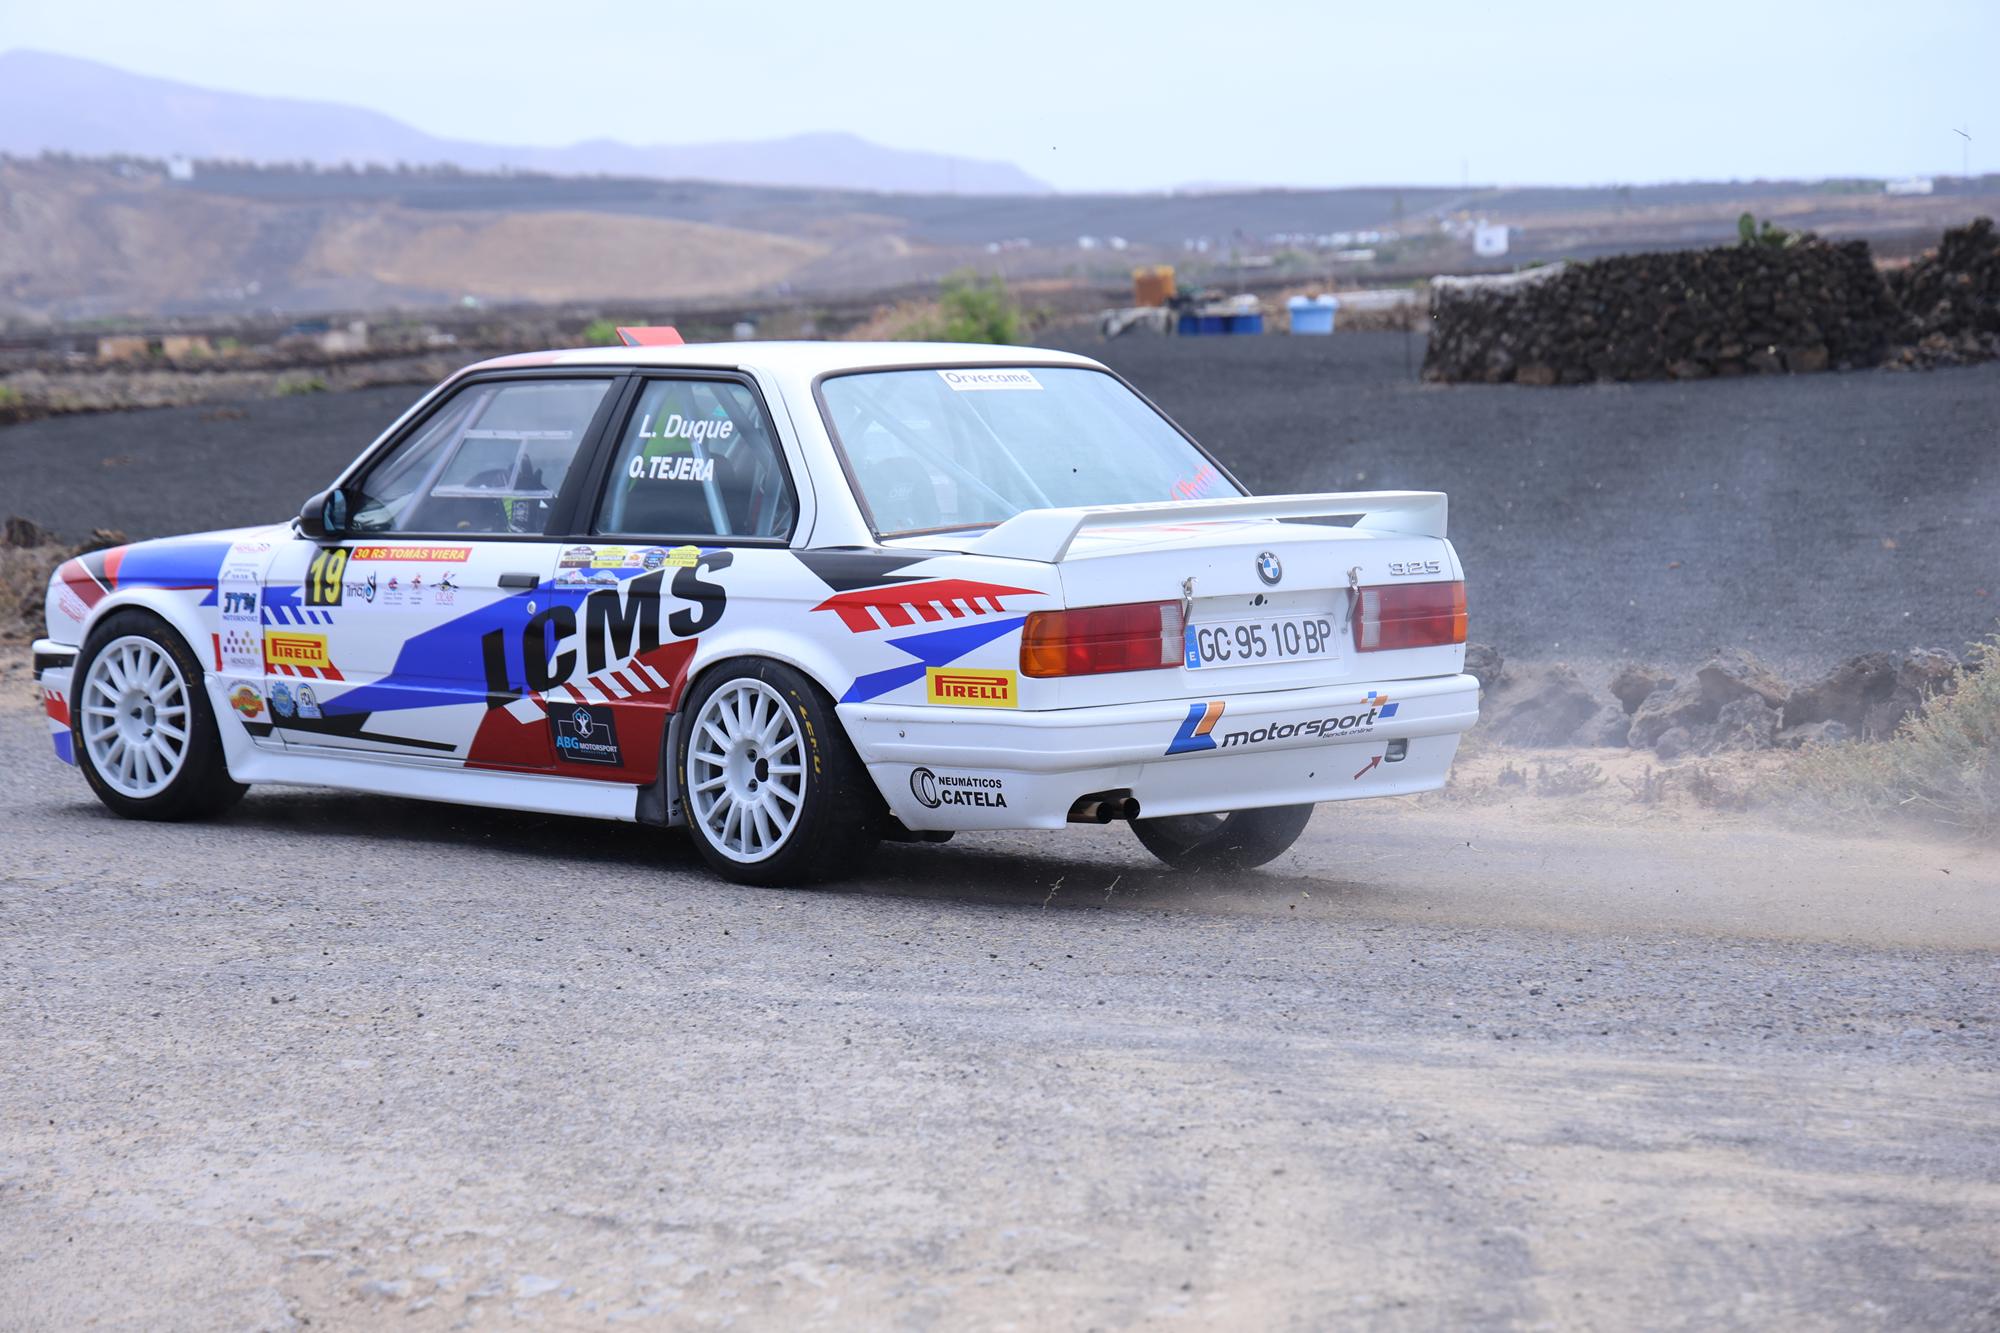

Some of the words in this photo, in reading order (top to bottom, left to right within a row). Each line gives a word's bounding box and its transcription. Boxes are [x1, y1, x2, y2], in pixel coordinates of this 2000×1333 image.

[639, 414, 657, 438] L.
[663, 414, 733, 444] Duque
[628, 455, 645, 478] O.
[649, 456, 715, 481] TEJERA
[355, 549, 370, 559] 30
[371, 549, 387, 559] RS
[431, 549, 466, 560] VIERA
[310, 548, 347, 604] 19
[1388, 560, 1441, 576] 325
[481, 551, 734, 711] LCMS
[1197, 627, 1231, 662] GC
[1234, 624, 1268, 660] 95
[1271, 621, 1301, 657] 10
[1302, 619, 1331, 654] BP
[271, 638, 323, 660] PIRELLI
[1188, 651, 1197, 661] E
[934, 675, 1009, 700] PIRELLI
[1221, 707, 1378, 747] motorsport
[556, 735, 580, 750] ABG
[579, 742, 618, 753] MOTORSPORT
[938, 776, 1003, 789] NEUMÁTICOS
[941, 789, 1008, 809] CATELA
